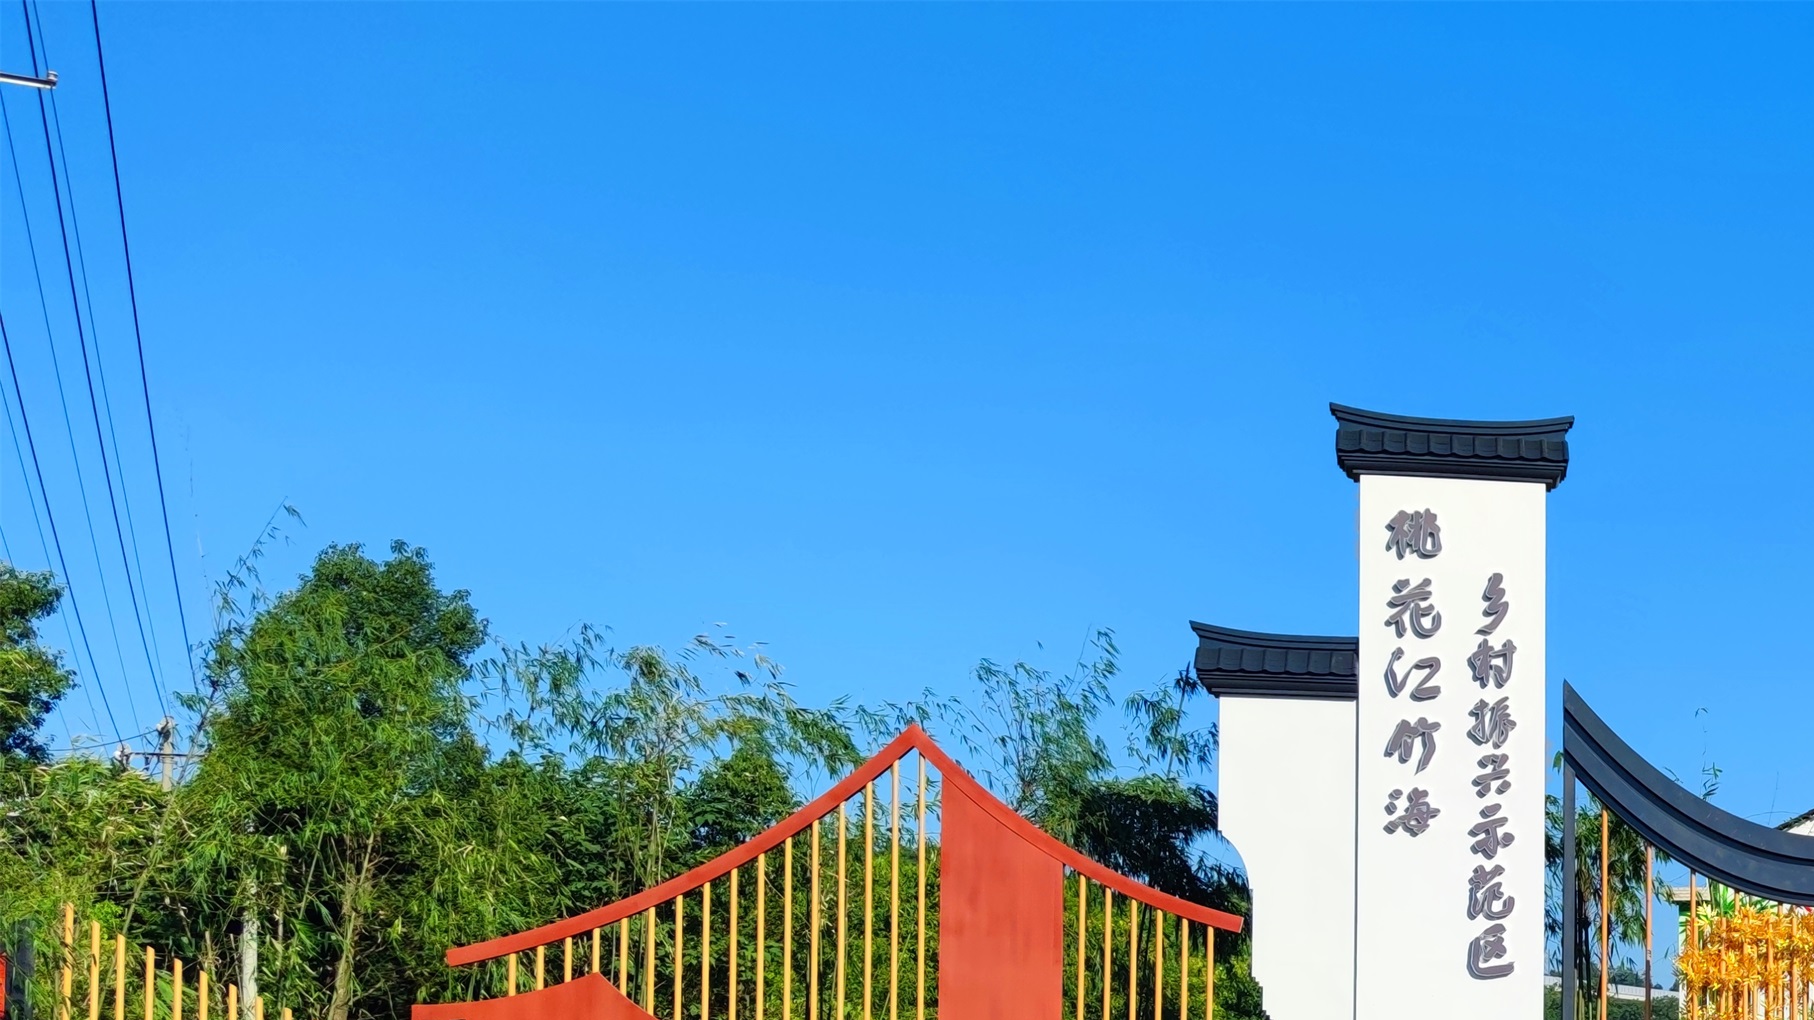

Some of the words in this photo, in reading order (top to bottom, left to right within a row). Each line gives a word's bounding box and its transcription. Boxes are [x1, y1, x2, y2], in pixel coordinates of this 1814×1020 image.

[1384, 508, 1442, 836] 桃花江竹海
[1467, 572, 1517, 979] 乡村振兴示范区
